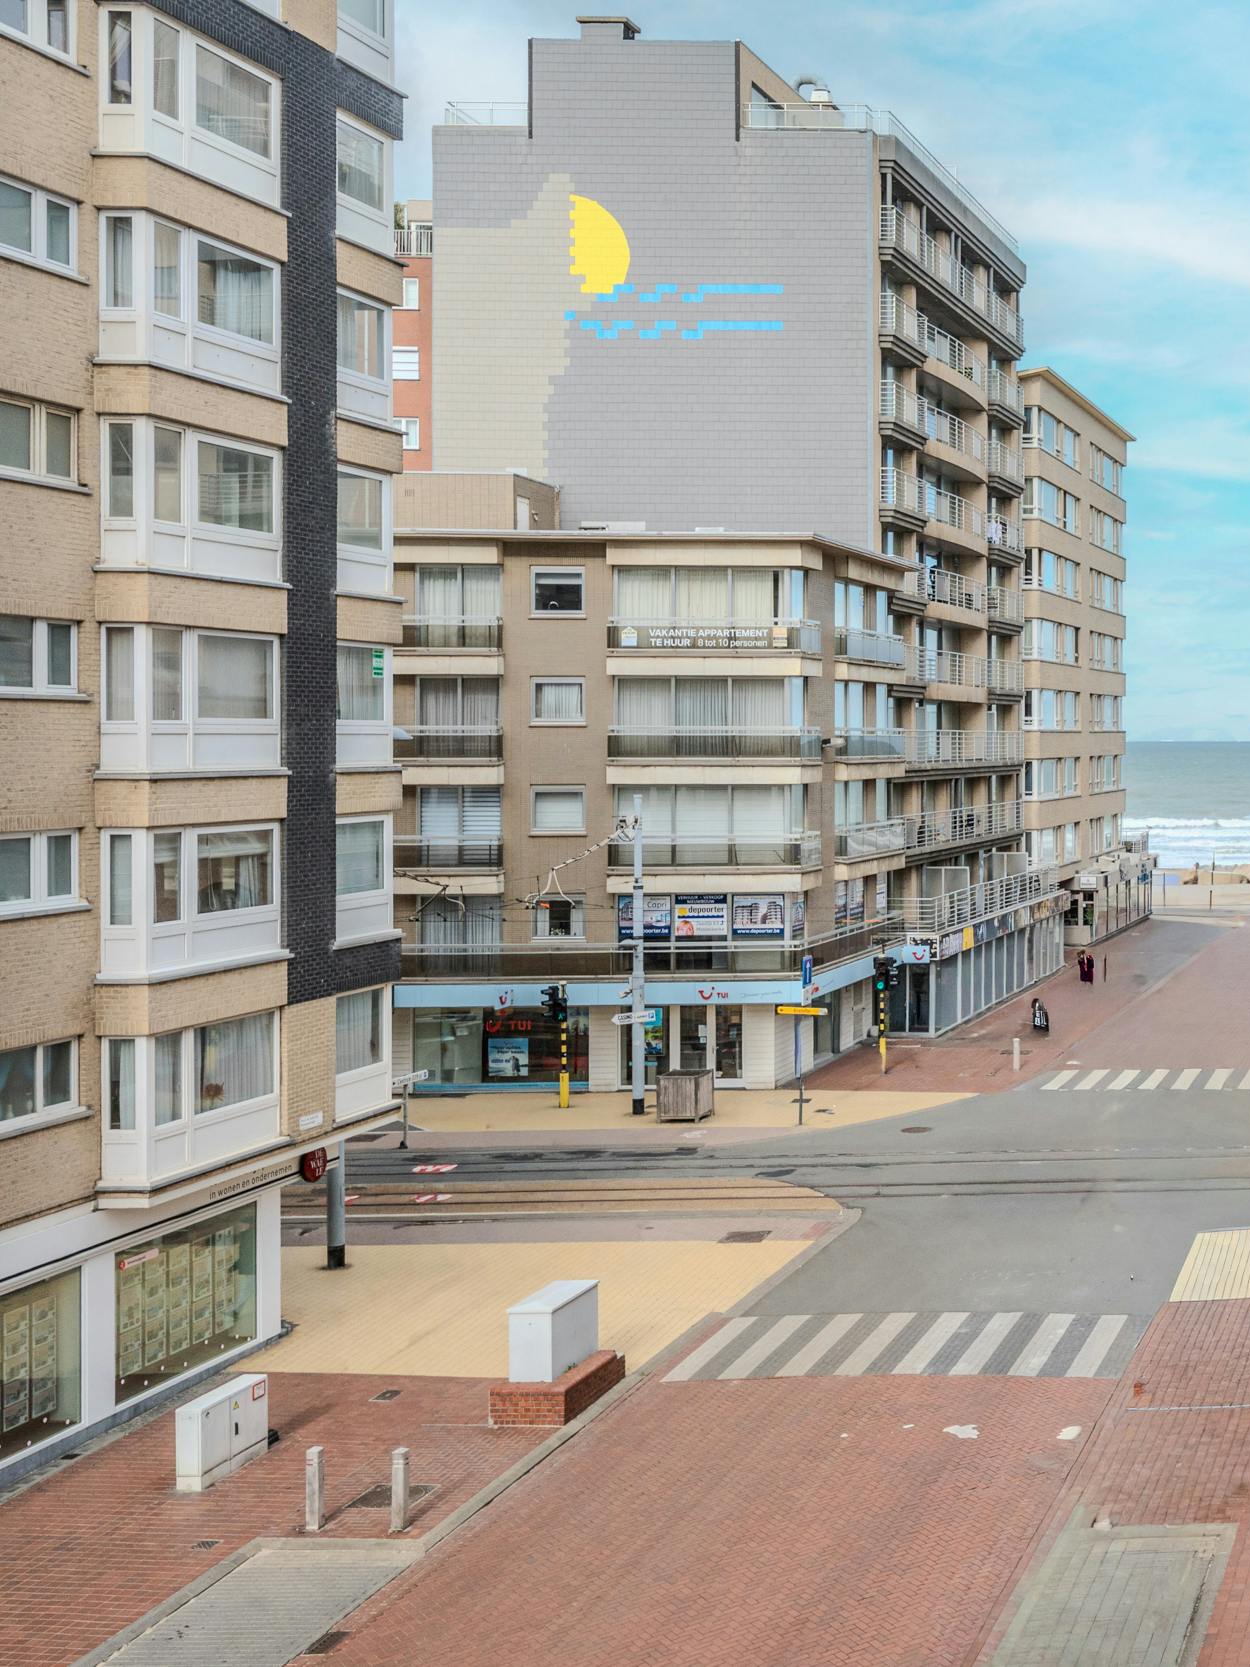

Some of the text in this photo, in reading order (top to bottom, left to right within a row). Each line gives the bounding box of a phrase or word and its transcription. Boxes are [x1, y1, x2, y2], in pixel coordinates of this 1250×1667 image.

[649, 629, 768, 637] VAKANTIE APPARTEMENT
[650, 639, 768, 648] TE HUUR 8 tot 10 personen
[647, 901, 667, 910] Capri
[688, 905, 724, 915] depoorter
[510, 1020, 532, 1031] TUI
[209, 1191, 216, 1200] in
[217, 1183, 241, 1197] wonen
[241, 1179, 251, 1188] en
[251, 1164, 293, 1185] ondernemen
